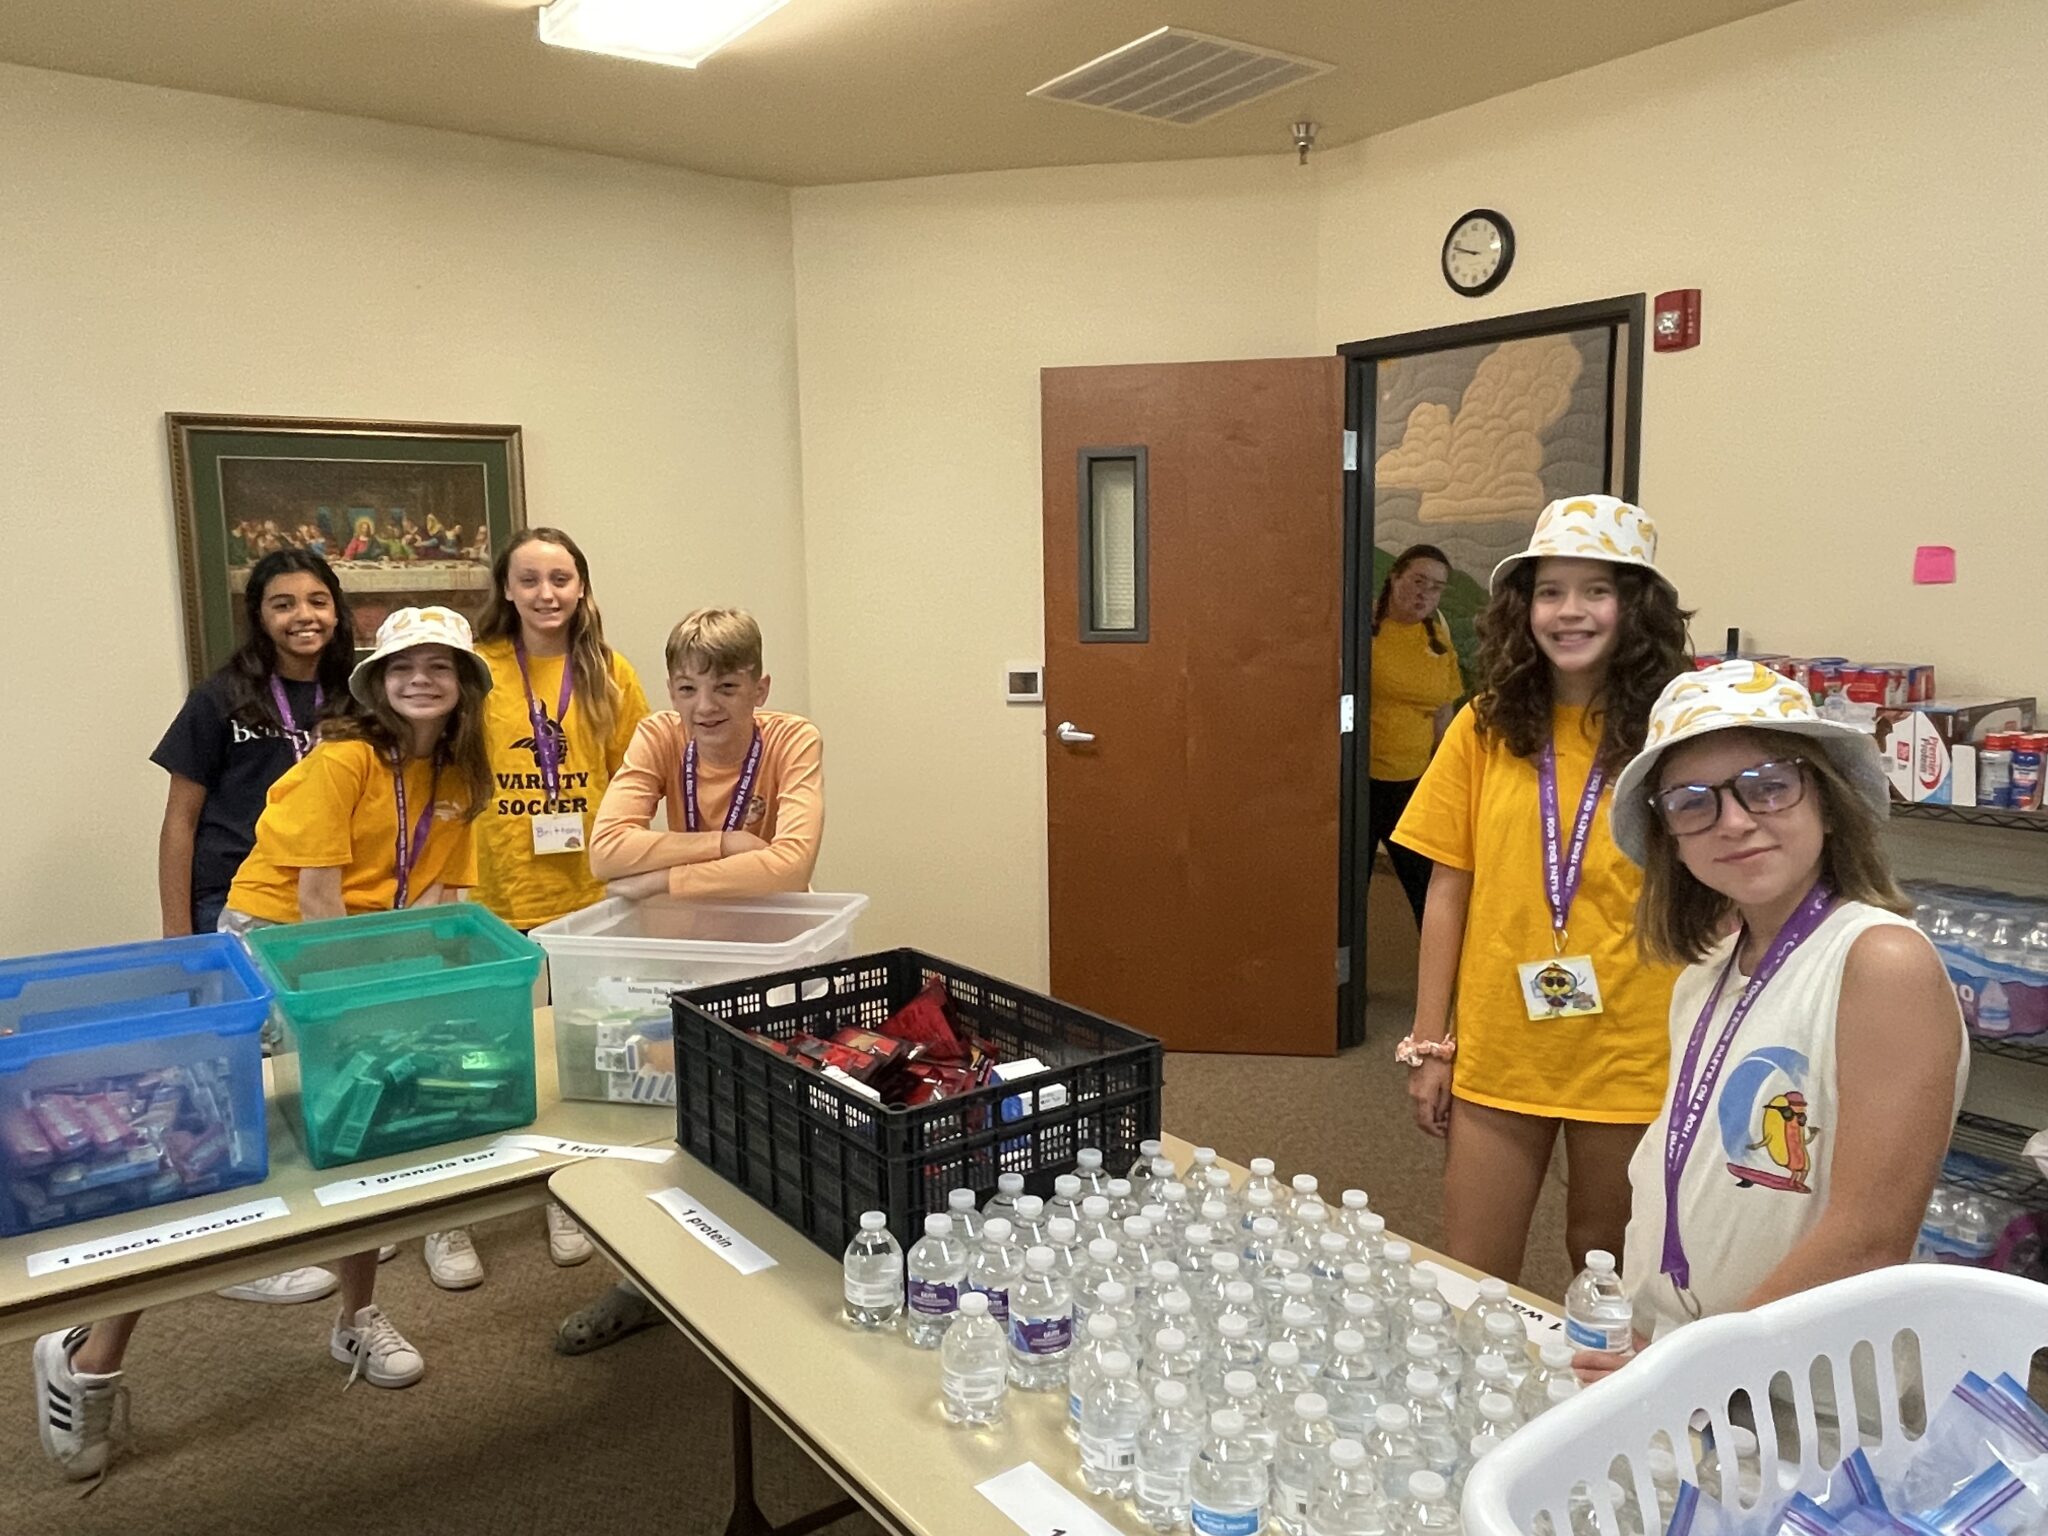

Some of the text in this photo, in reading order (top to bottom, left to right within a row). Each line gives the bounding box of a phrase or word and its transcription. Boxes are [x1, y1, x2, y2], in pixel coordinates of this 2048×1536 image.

[1919, 737, 1929, 774] Protein
[1927, 736, 1939, 776] Premier
[497, 772, 589, 790] VARTY
[1692, 1102, 1700, 1111] A
[1696, 1084, 1708, 1102] ON
[570, 1144, 609, 1154] fruit
[356, 1151, 497, 1187] 1 granola bar
[57, 1211, 266, 1265] 1 snack cracker
[682, 1208, 733, 1249] 1 protein
[1548, 1321, 1563, 1332] 1
